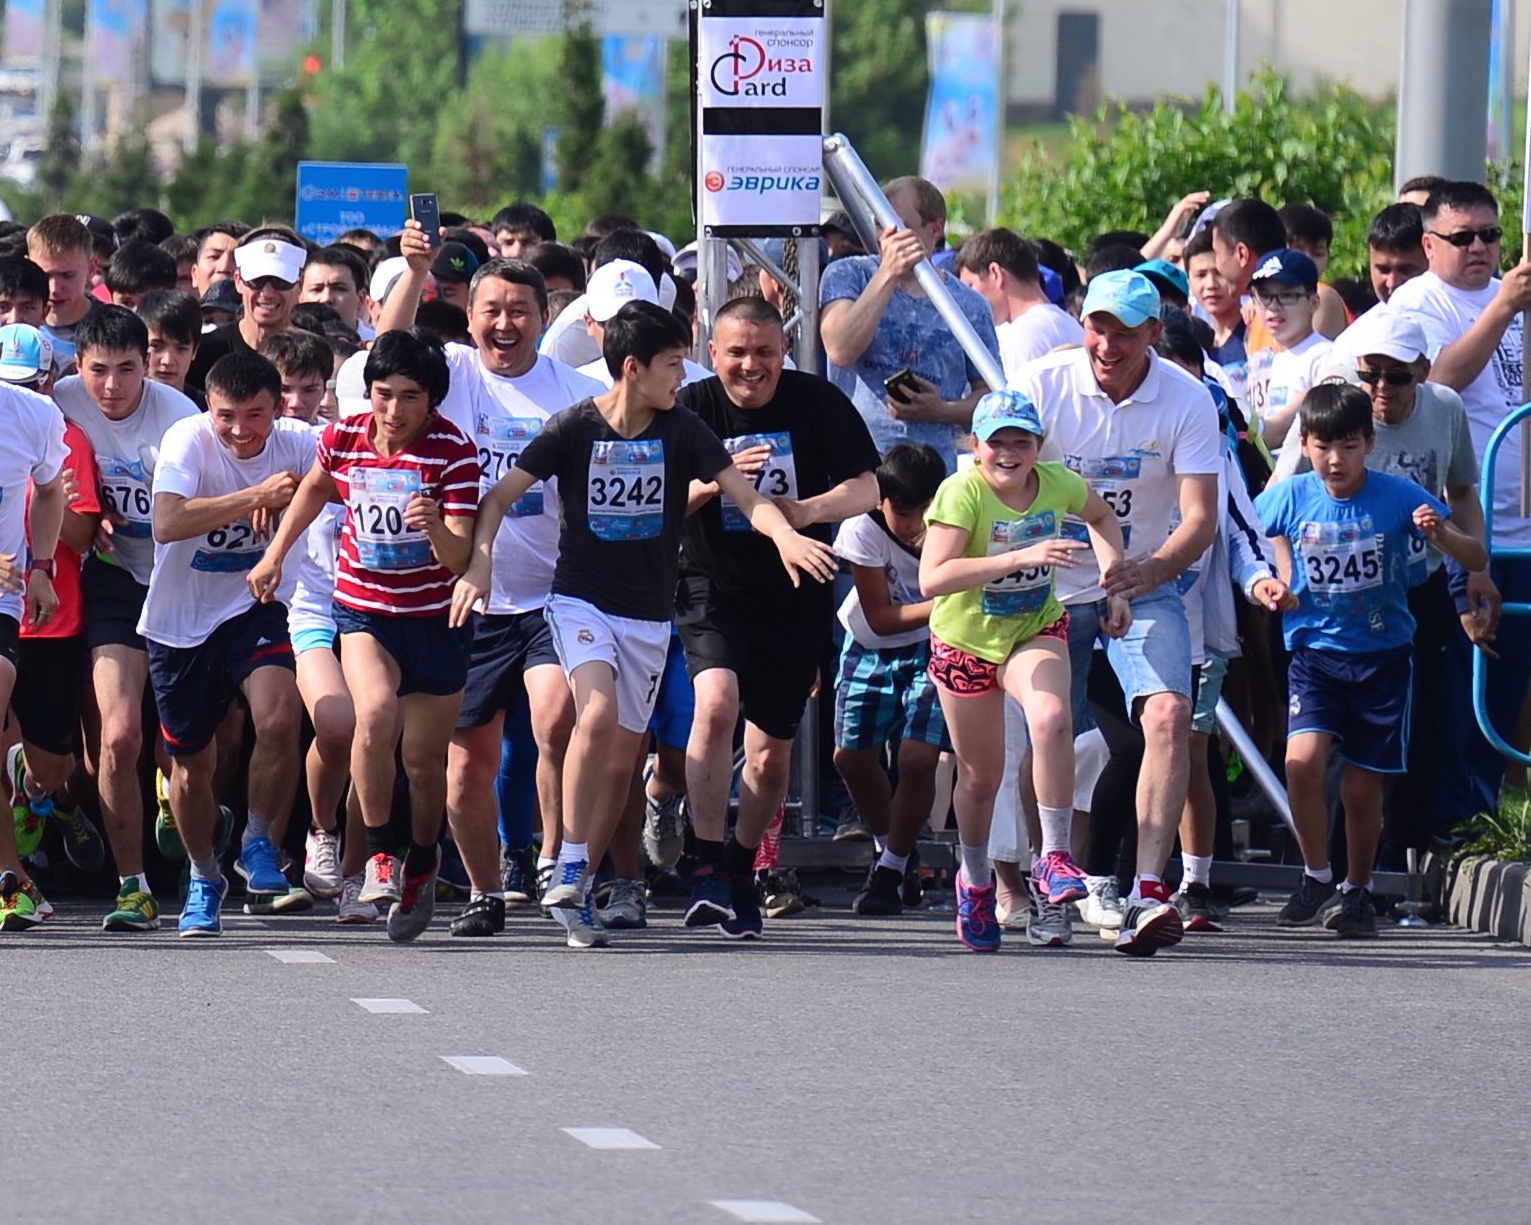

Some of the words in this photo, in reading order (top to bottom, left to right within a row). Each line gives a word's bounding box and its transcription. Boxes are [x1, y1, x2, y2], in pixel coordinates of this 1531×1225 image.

[767, 38, 814, 49] спонсор
[726, 176, 820, 195] эврика
[589, 475, 663, 508] 3242
[353, 503, 422, 536] 120
[1306, 548, 1379, 585] 3245
